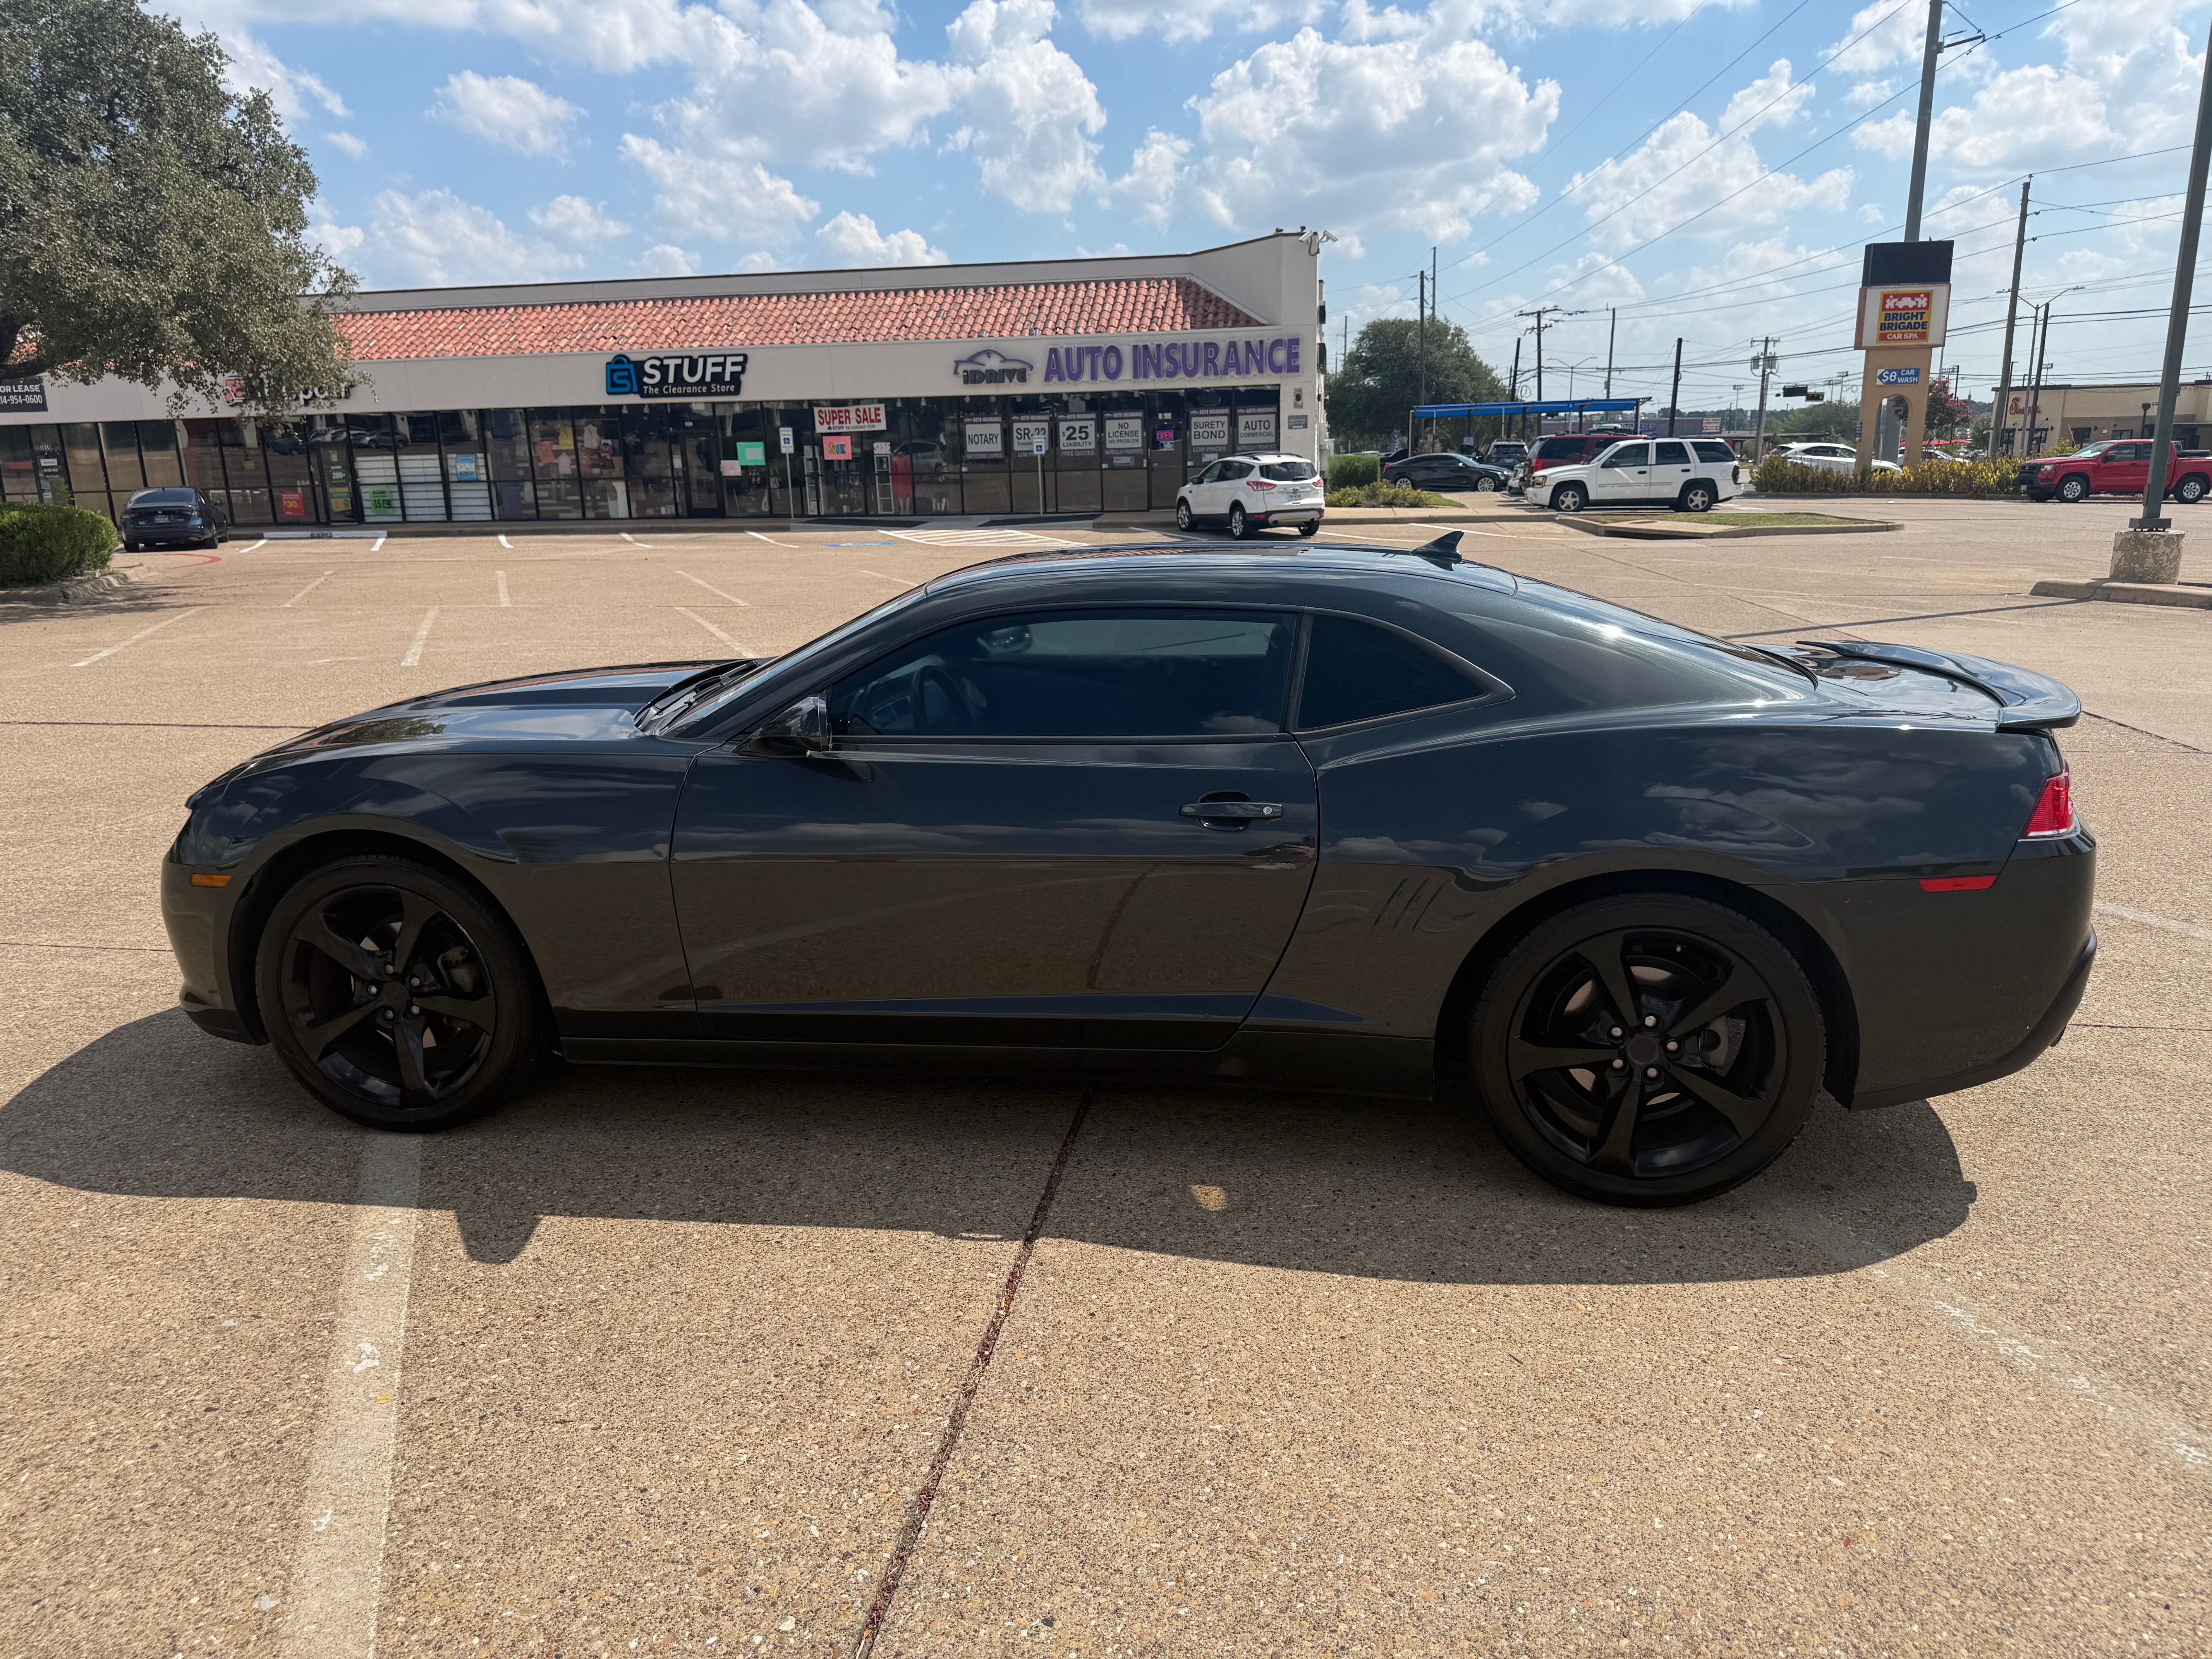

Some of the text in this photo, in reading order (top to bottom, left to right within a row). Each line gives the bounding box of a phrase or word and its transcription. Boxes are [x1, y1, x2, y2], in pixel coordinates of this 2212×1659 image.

[1884, 312, 1925, 321] BRIGHT
[1879, 321, 1928, 331] BRIGADE
[1043, 338, 1301, 382] AUTO INSURANCE
[642, 356, 744, 385] STUFF
[963, 368, 1027, 385] iDRIVE
[1882, 370, 1897, 383] $6
[13, 384, 41, 392] LEASE
[643, 384, 735, 395] The Clearance Store
[0, 395, 43, 405] 14-954-0600
[818, 407, 881, 426] SUPER SALE
[1193, 421, 1226, 429] SURETY
[1244, 420, 1271, 431] AUTO
[968, 433, 999, 445] NOTARY
[1158, 431, 1173, 440] OPEN
[1194, 430, 1226, 439] BOND
